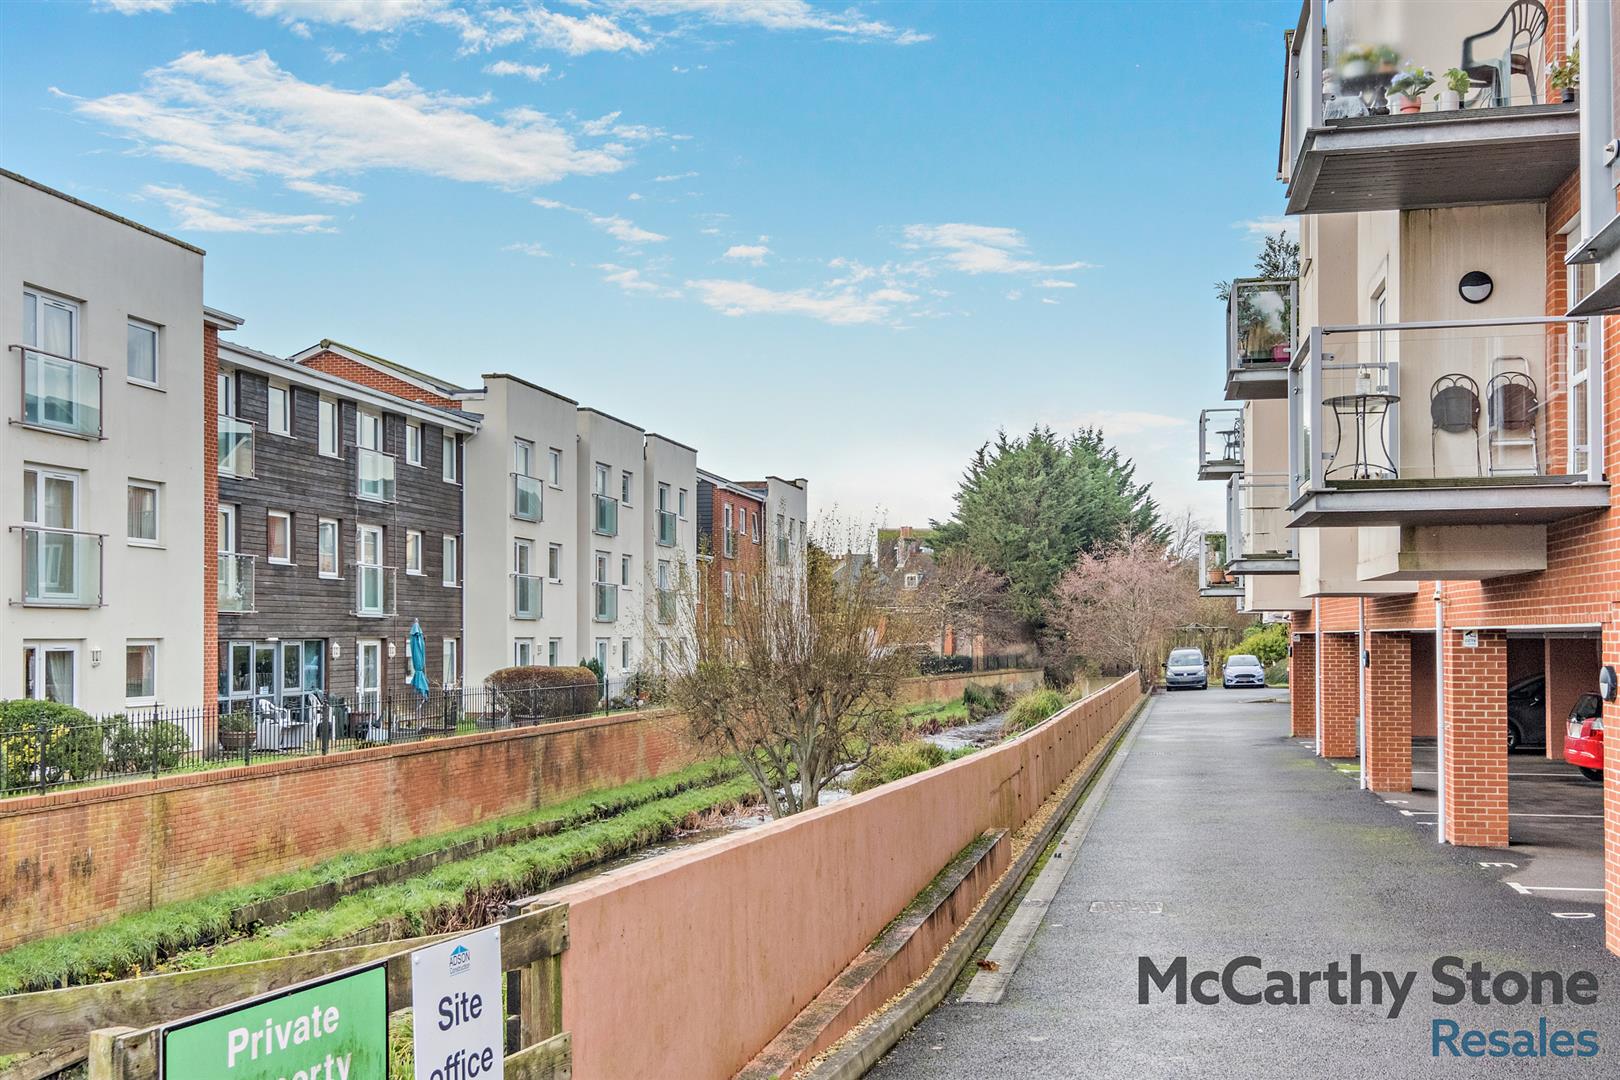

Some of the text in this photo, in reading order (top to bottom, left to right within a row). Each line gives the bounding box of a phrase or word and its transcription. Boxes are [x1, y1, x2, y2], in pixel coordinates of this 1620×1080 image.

[449, 951, 471, 967] ADSON
[438, 992, 482, 1031] Site
[227, 1005, 340, 1068] Private
